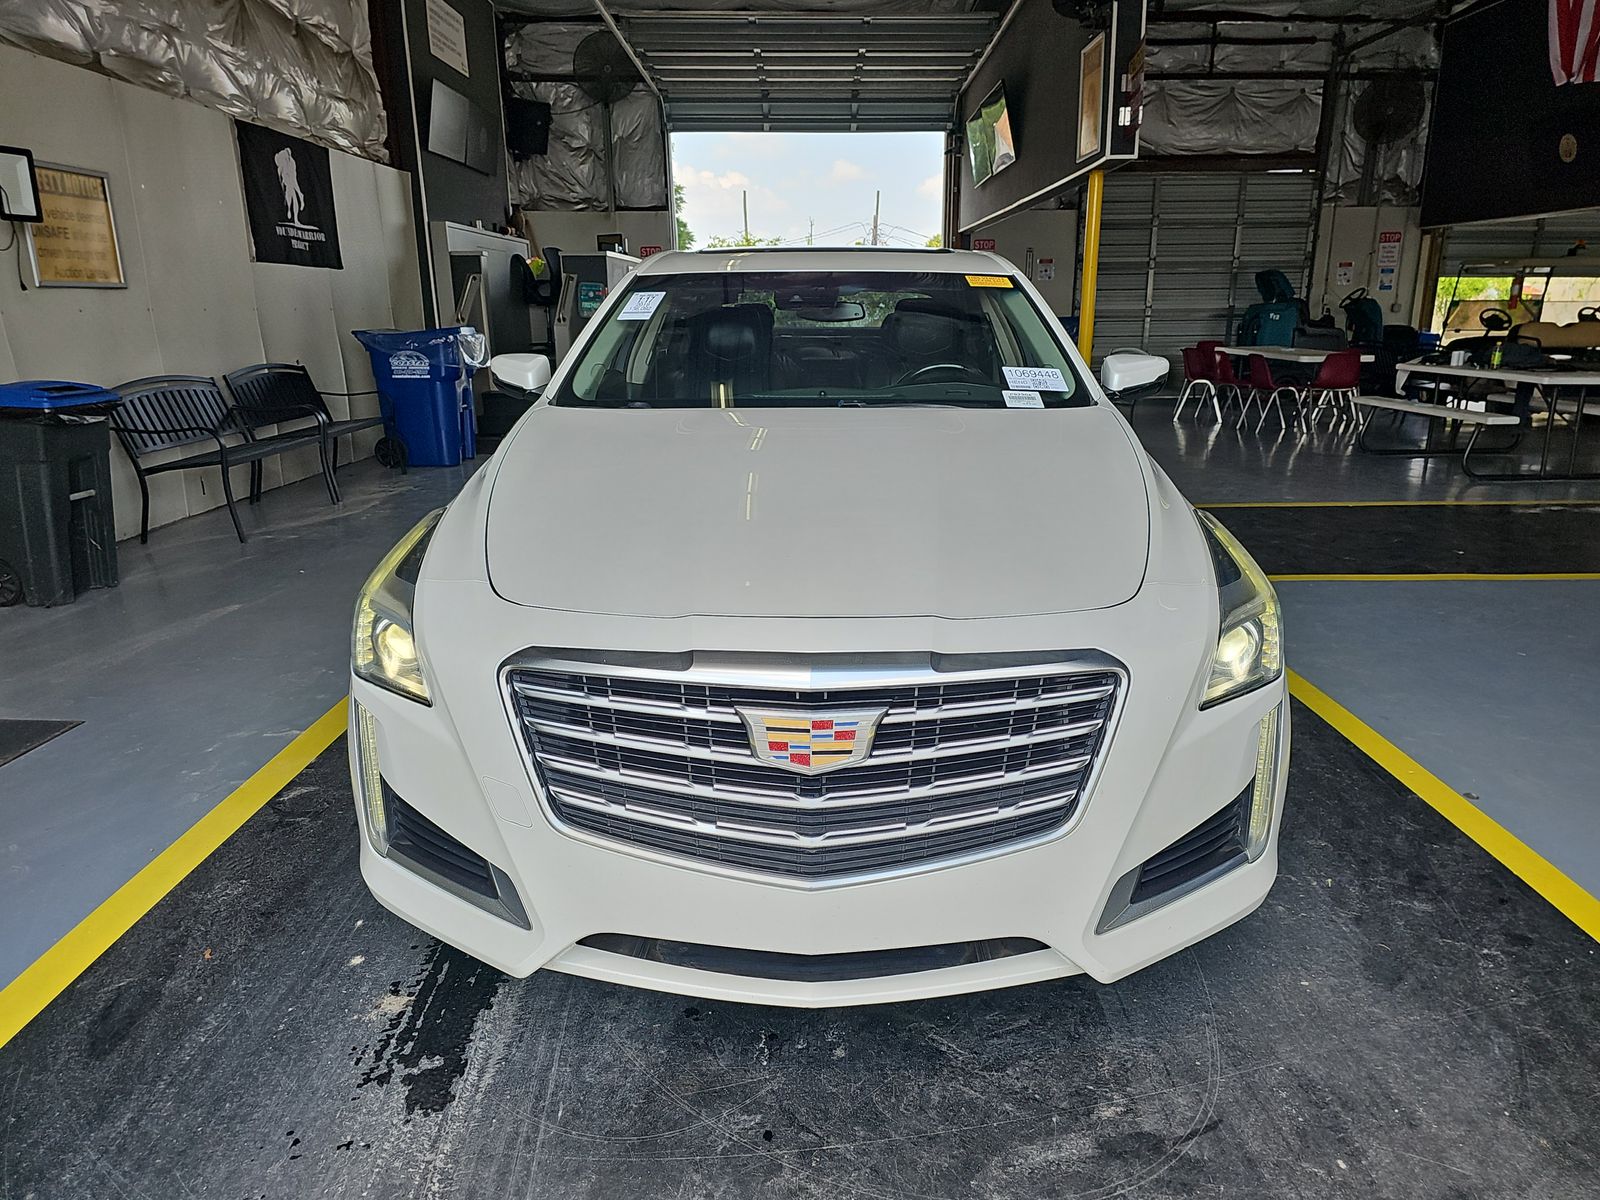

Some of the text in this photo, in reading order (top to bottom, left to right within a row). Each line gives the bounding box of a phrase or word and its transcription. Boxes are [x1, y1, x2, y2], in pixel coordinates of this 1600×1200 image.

[1380, 233, 1401, 242] STOP
[974, 240, 995, 249] STOP
[1008, 369, 1060, 380] 1069448
